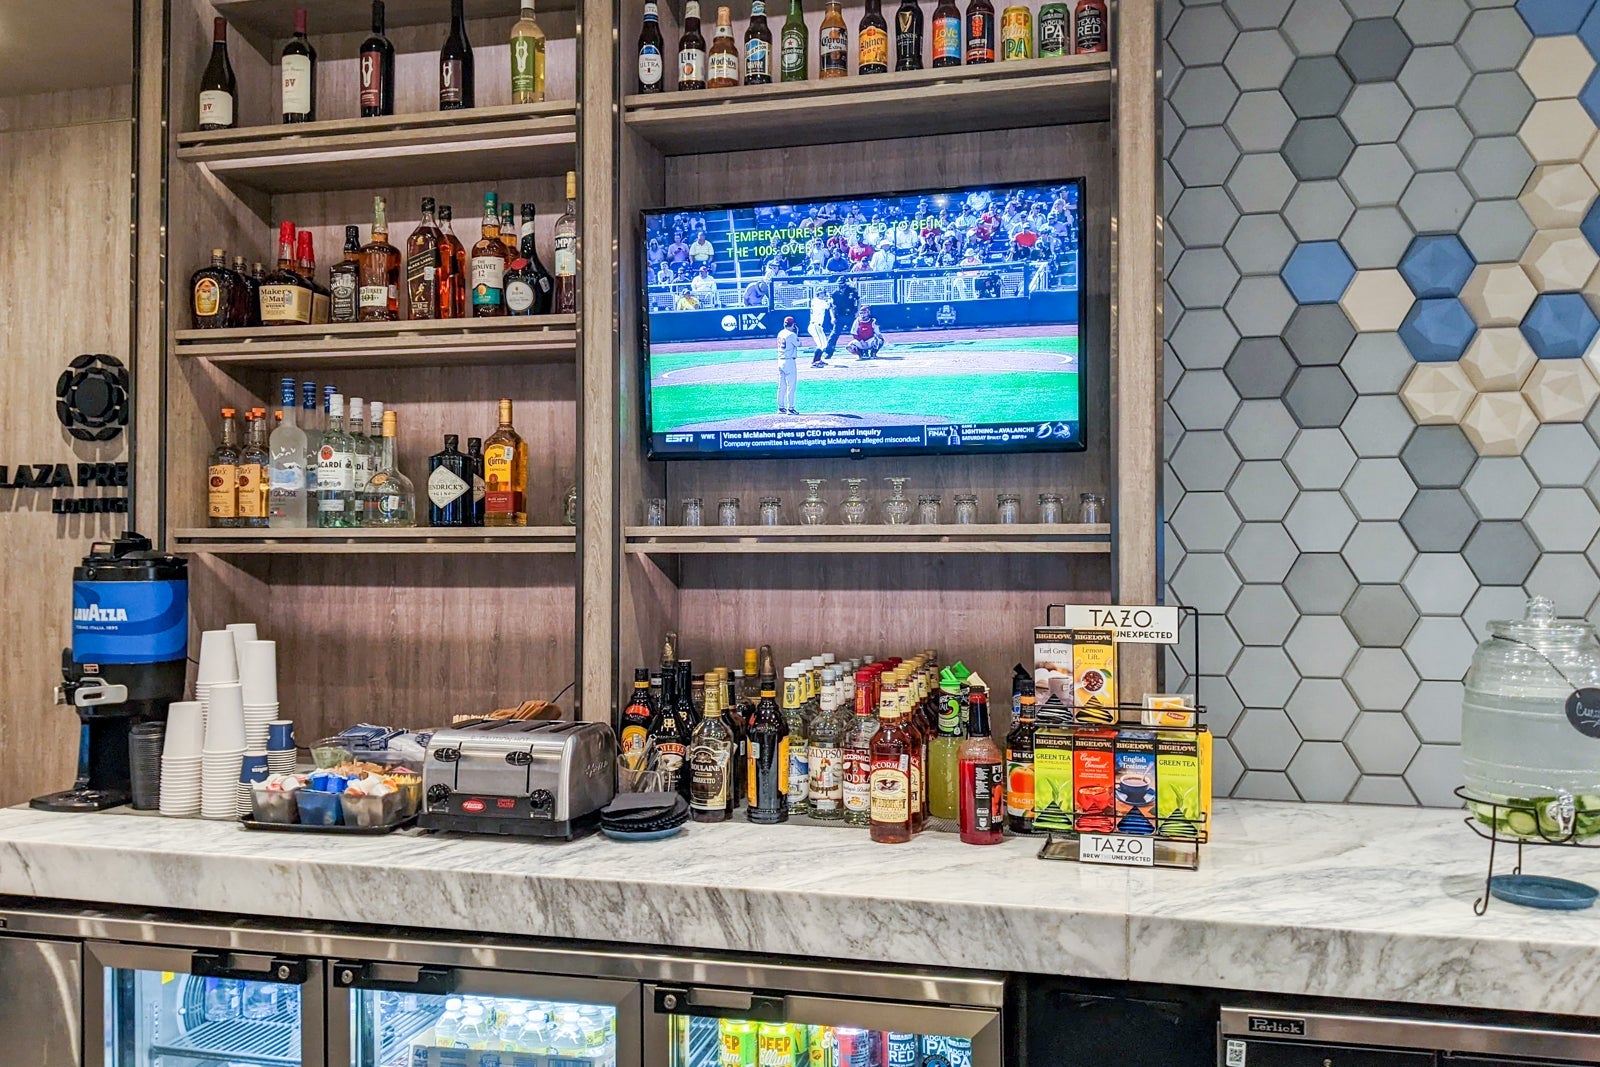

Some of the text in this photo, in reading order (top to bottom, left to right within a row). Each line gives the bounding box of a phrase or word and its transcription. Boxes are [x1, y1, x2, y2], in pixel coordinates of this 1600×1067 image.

[1001, 14, 1030, 26] DEEP
[1077, 17, 1102, 27] TEXAS
[935, 27, 958, 39] LOVE
[1041, 25, 1065, 40] IPA
[1077, 24, 1101, 38] RED
[860, 37, 884, 51] Shiner
[862, 47, 882, 57] BOCK
[680, 52, 697, 64] Lite
[284, 78, 296, 87] BV
[203, 103, 213, 111] BV
[726, 218, 944, 243] TEMPERATURE IS EXPECTED TO BE IN
[727, 243, 814, 259] THE 100s OVER
[472, 263, 497, 271] ENLIVET
[261, 287, 292, 295] Maker's
[723, 428, 882, 440] Vince McMahon gives up CEO role amid inquiry
[999, 426, 1035, 434] AVALANCHE
[666, 433, 694, 443] ESPN
[723, 440, 750, 448] Company
[751, 438, 783, 447] committee
[790, 437, 827, 447] investigating
[827, 436, 862, 445] McMahon's
[862, 436, 884, 445] alleged
[885, 435, 921, 443] misconduct
[487, 456, 508, 467] Cuervo
[273, 490, 297, 498] GOOSE
[1089, 609, 1152, 628] TAZO
[1116, 630, 1173, 640] UNEXPECTED
[1076, 740, 1112, 748] BIGELOW
[1116, 742, 1154, 750] BIGELOW
[1159, 744, 1197, 752] BIGELOW
[1123, 755, 1147, 763] English
[1091, 837, 1143, 855] TAZO
[1112, 855, 1152, 863] UNEXPECTED
[1252, 1018, 1301, 1034] Perlick
[760, 1035, 791, 1052] DEEP
[889, 1041, 915, 1051] TEXAS
[922, 1038, 949, 1057] IPA
[889, 1050, 915, 1063] RED
